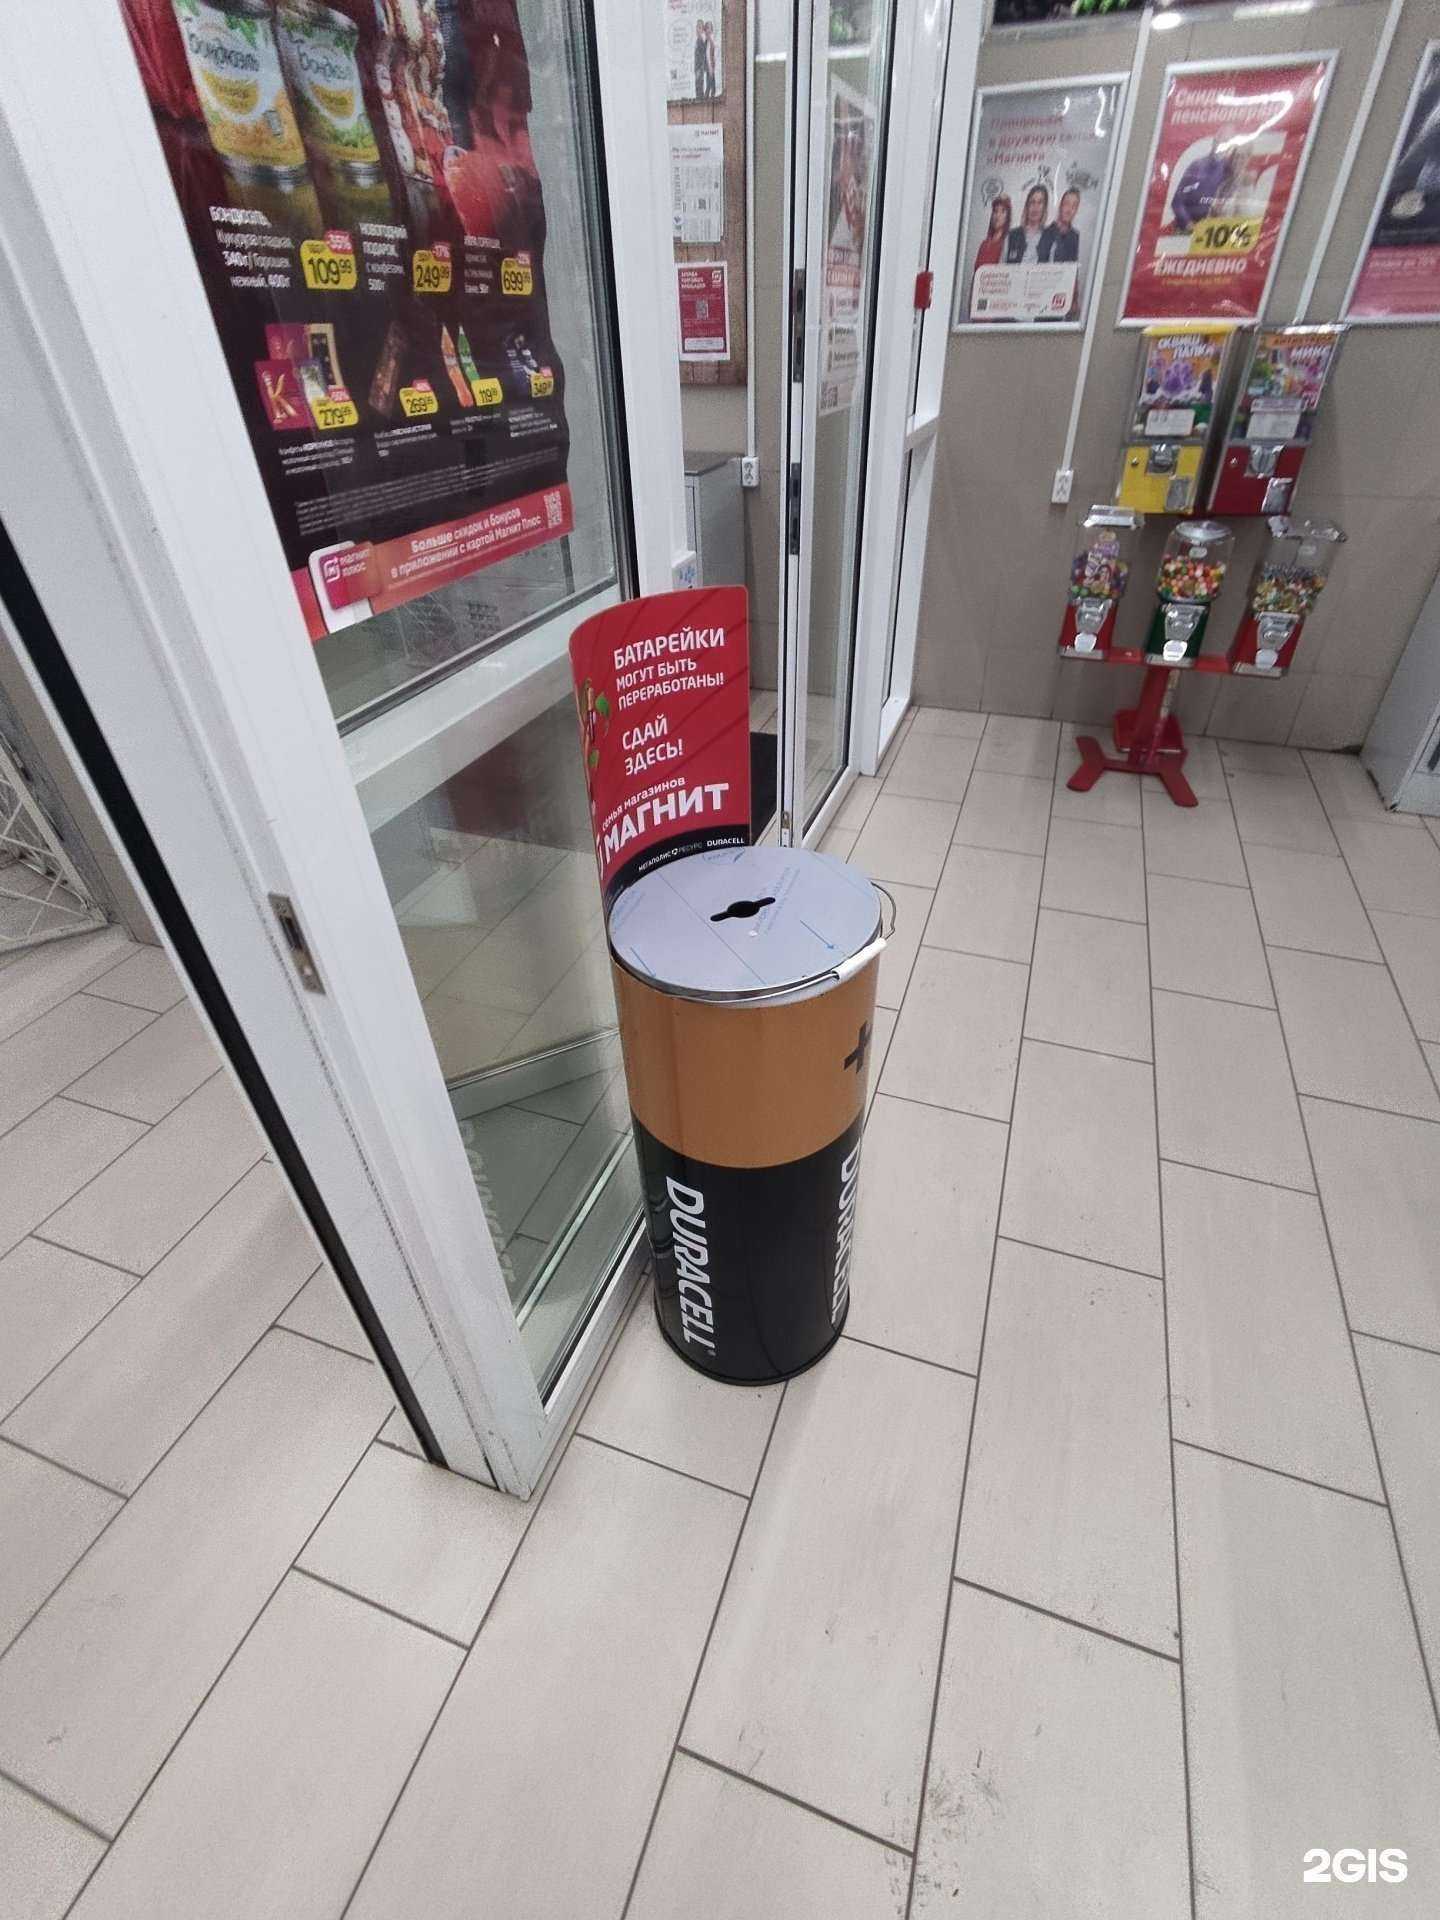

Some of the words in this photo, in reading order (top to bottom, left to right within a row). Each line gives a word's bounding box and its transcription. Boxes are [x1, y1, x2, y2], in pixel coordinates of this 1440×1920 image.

[411, 532, 454, 553] Больше
[614, 626, 725, 670] БАТАРЕЙКИ
[616, 665, 655, 691] МОГУТ
[657, 658, 697, 677] БЫТЬ
[618, 672, 724, 711] ПЕРЕРАБОТАНЫ!
[622, 713, 668, 750] СДАЙ
[624, 739, 683, 776] ЗДЕСЬ!
[602, 803, 623, 831] семья
[624, 777, 686, 810] магазинов
[603, 782, 730, 865] МАГНИТ
[707, 837, 745, 848] DURACELL
[666, 1176, 716, 1349] DURACELL
